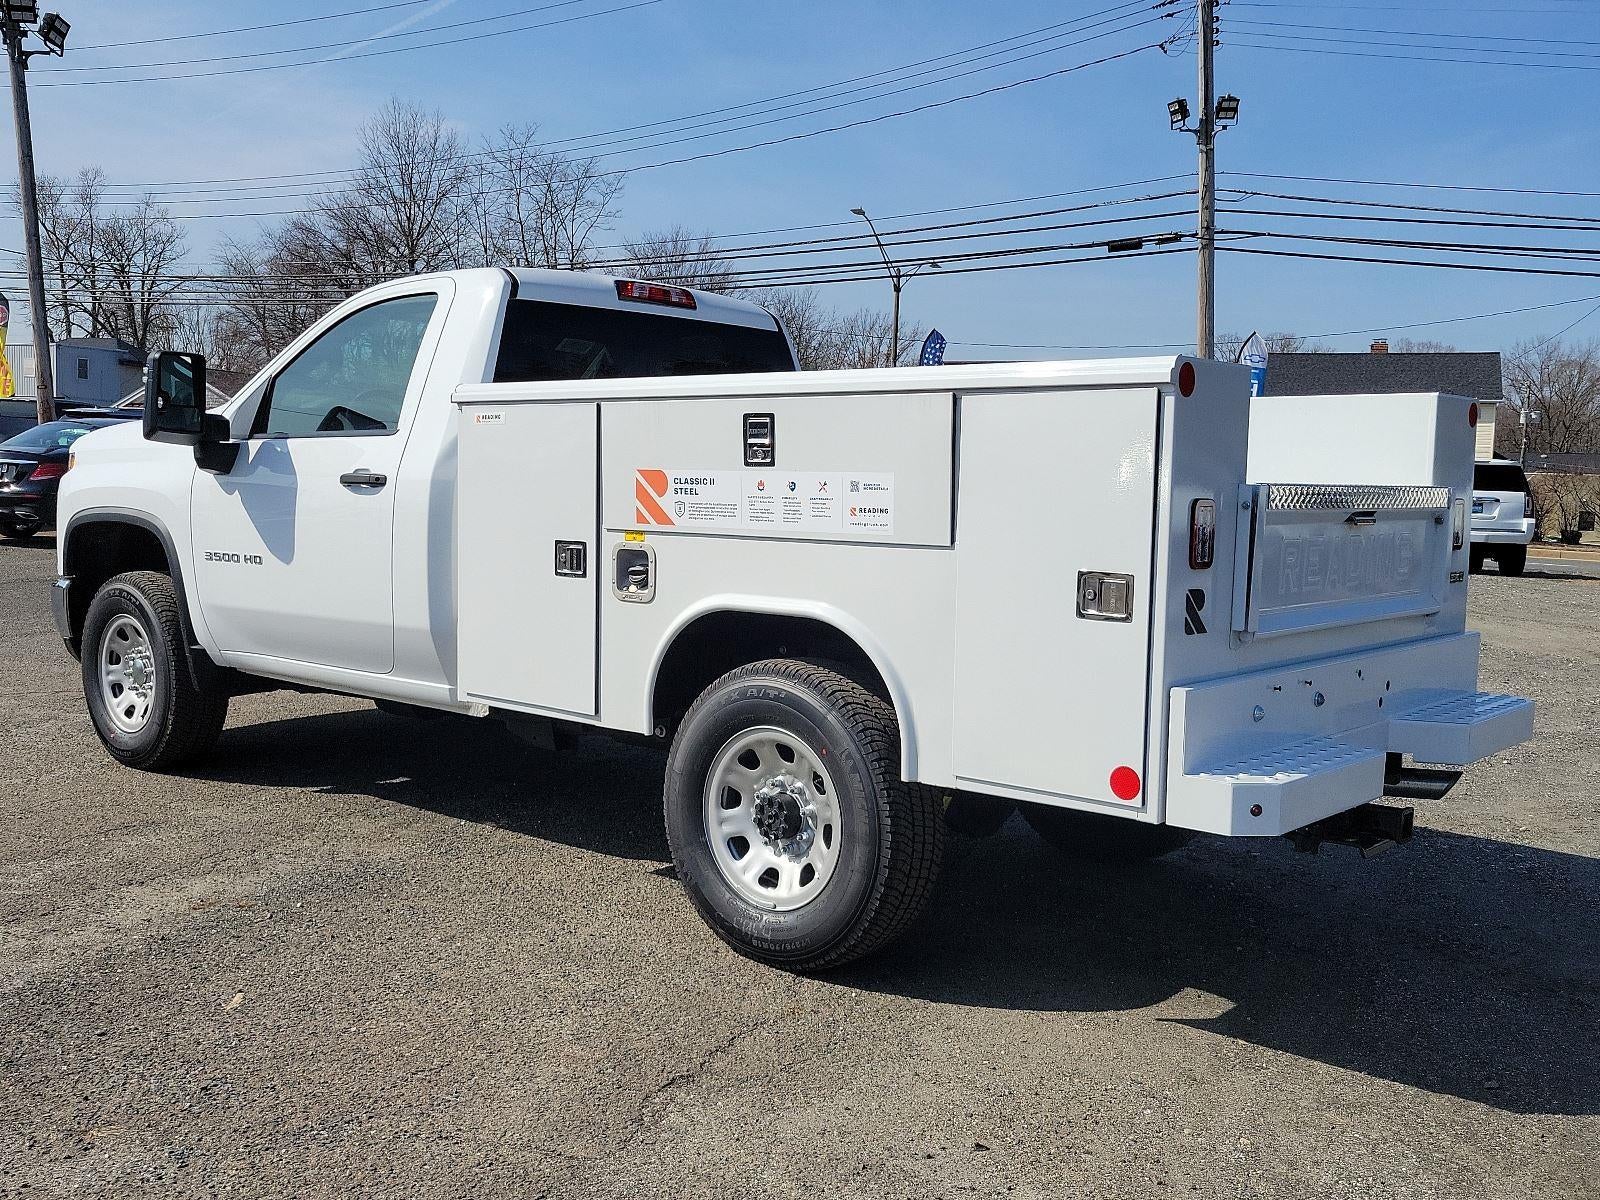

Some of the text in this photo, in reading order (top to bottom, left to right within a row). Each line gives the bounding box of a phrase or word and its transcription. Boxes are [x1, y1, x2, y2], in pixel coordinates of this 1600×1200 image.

[673, 477, 708, 486] CLASSIC
[673, 487, 699, 496] STEEL
[858, 507, 889, 515] READING
[204, 551, 263, 565] 3500 HD
